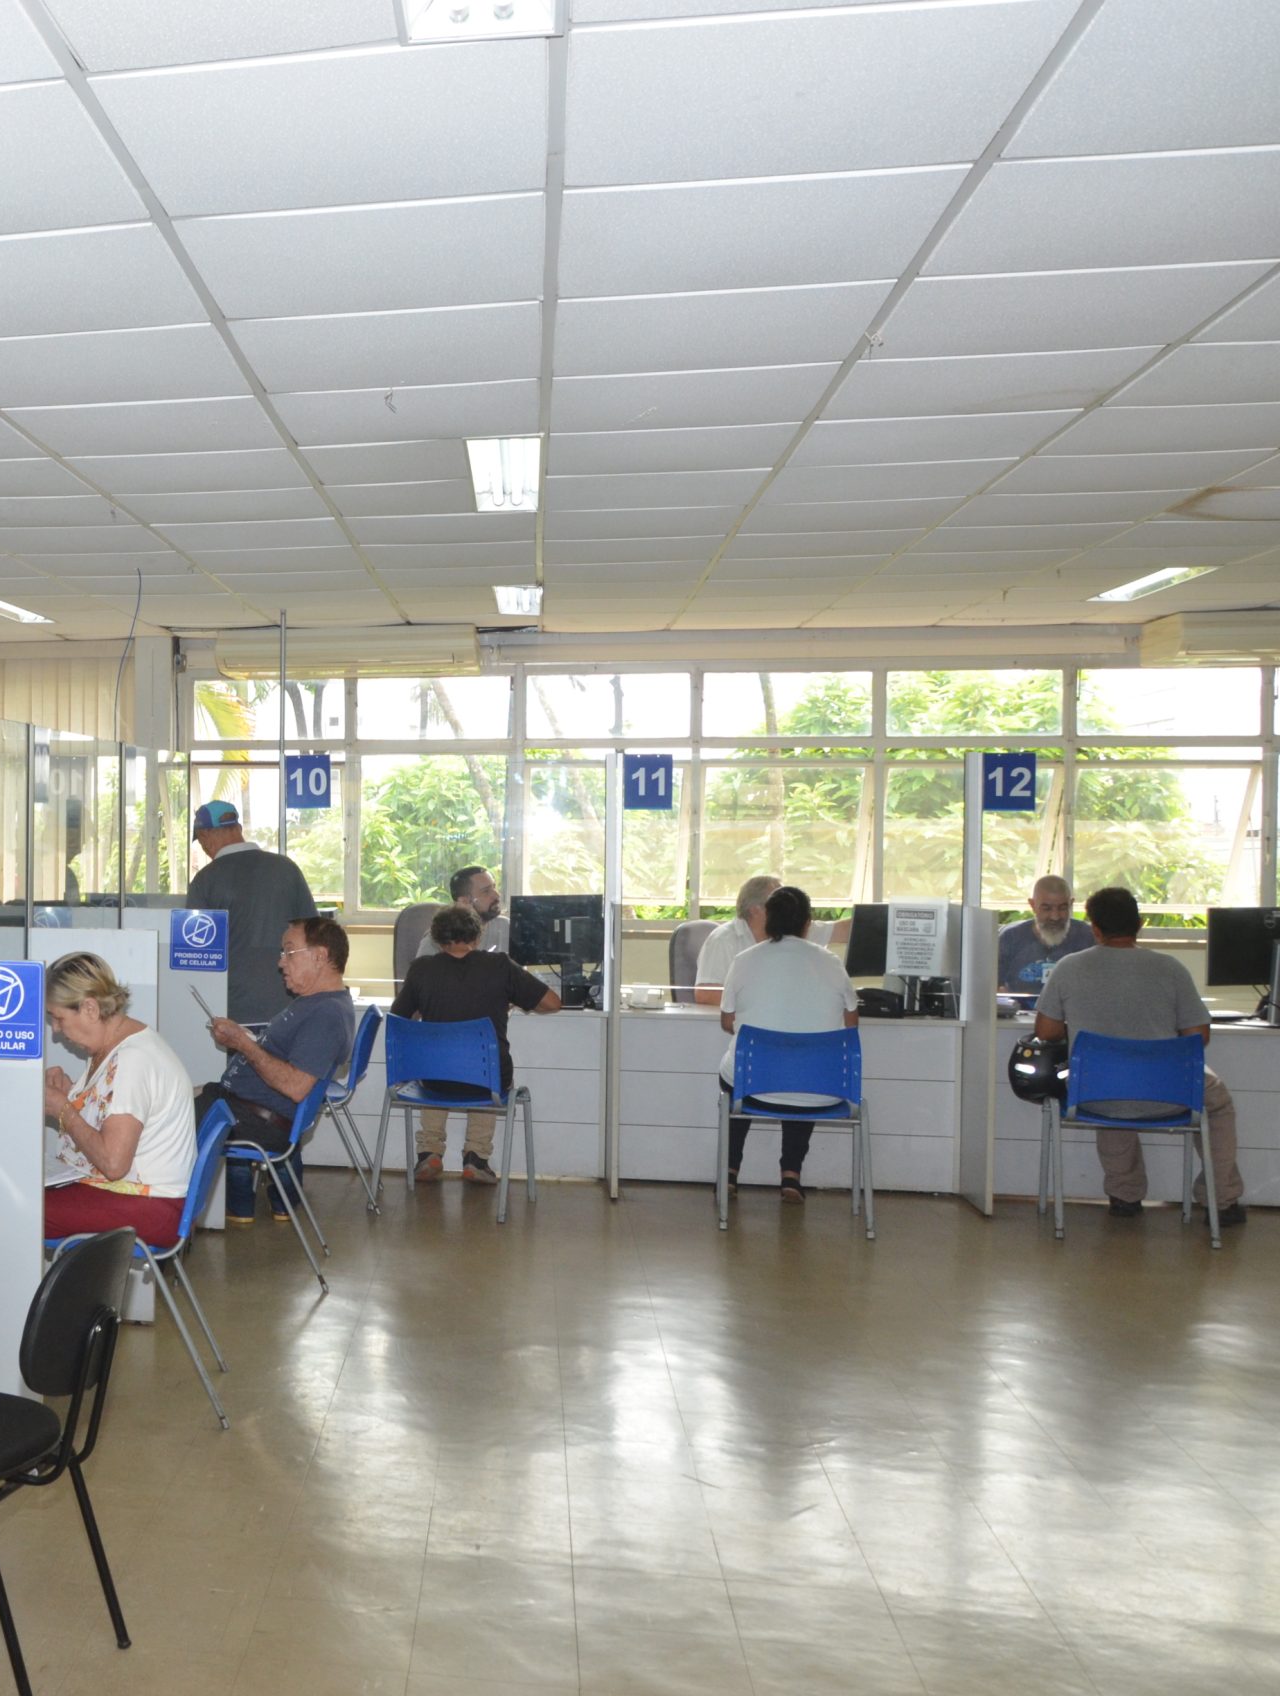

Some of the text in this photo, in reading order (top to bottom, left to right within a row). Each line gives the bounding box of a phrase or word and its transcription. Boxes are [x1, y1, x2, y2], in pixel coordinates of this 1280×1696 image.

[290, 767, 328, 796] 10
[631, 767, 666, 796] 11
[988, 766, 1032, 797] 12
[5, 1030, 13, 1039] O
[14, 1031, 35, 1040] USO
